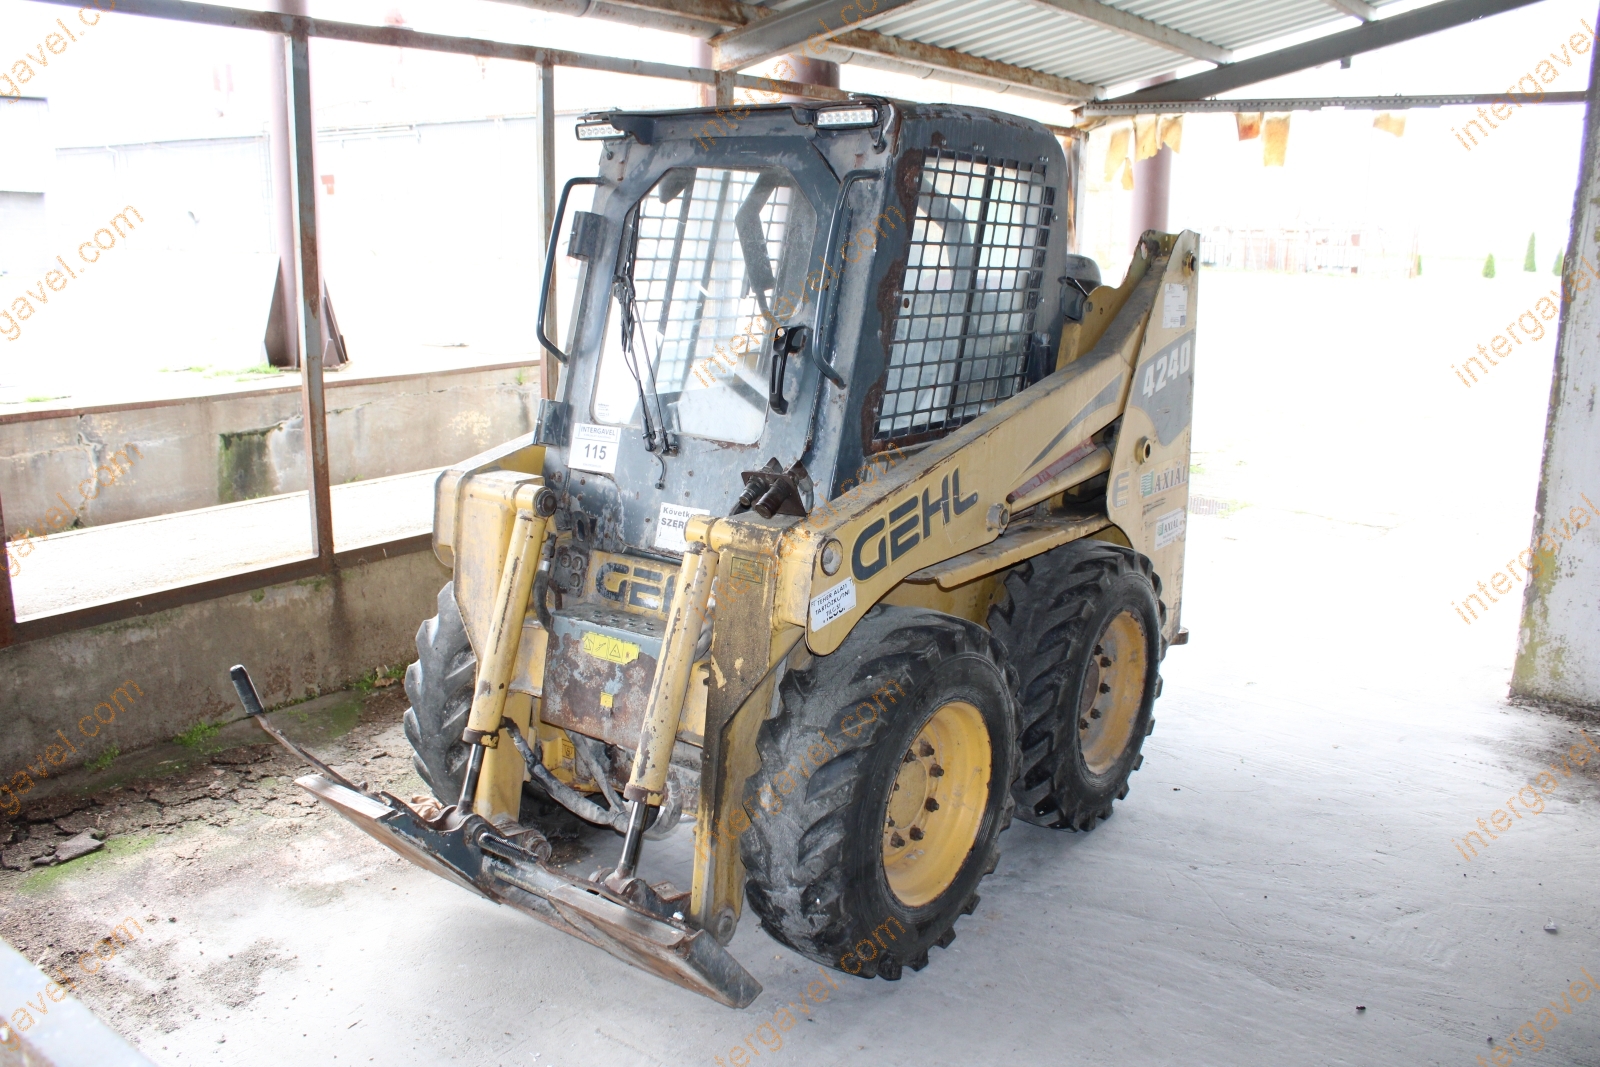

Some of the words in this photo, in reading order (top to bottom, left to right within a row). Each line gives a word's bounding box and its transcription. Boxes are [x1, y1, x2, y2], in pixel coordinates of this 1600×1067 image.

[1142, 339, 1191, 399] 4240
[580, 425, 616, 437] INTERGAVEL
[584, 443, 607, 460] 115
[660, 517, 686, 529] SZER
[851, 466, 979, 581] GEHL
